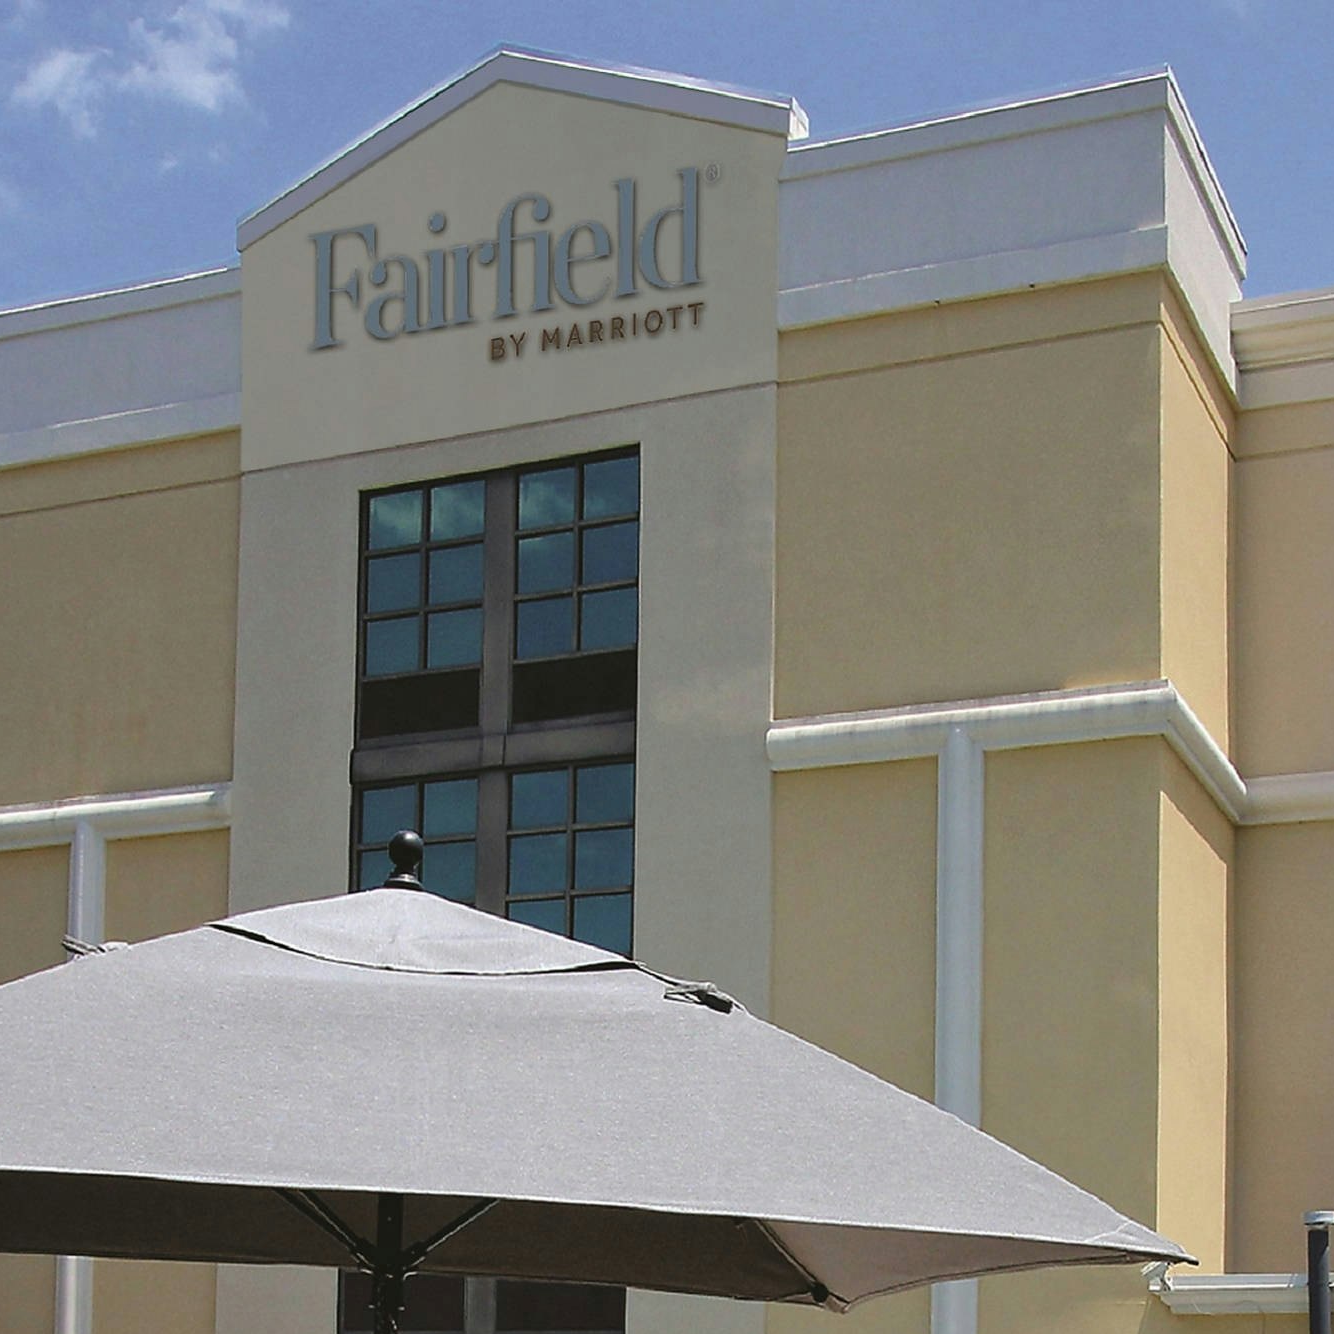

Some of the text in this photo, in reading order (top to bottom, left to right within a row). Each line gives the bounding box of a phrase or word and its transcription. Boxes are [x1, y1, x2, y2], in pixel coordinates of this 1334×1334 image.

[309, 167, 705, 352] Fairfield
[490, 302, 705, 361] BY MARRIOTT
